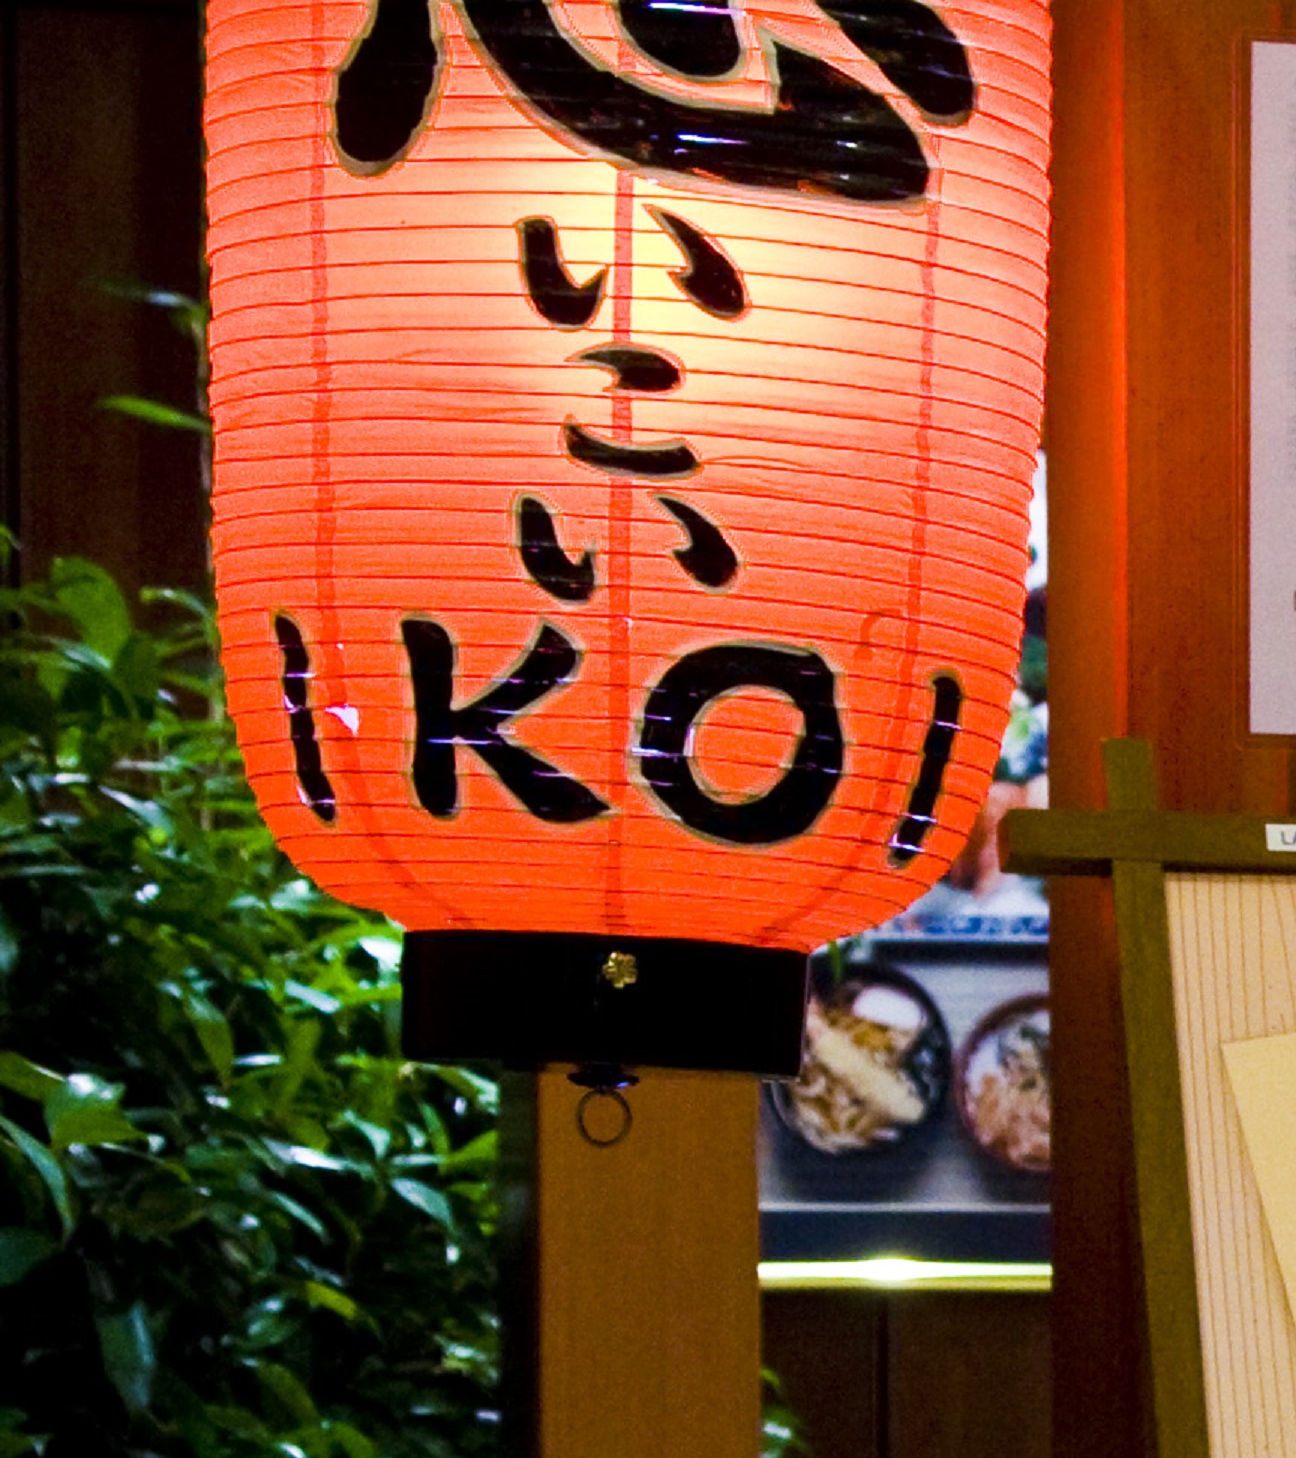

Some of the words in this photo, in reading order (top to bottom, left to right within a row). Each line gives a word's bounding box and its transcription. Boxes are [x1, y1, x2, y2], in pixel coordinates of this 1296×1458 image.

[515, 204, 747, 599] いこい
[273, 614, 964, 868] IKOI
